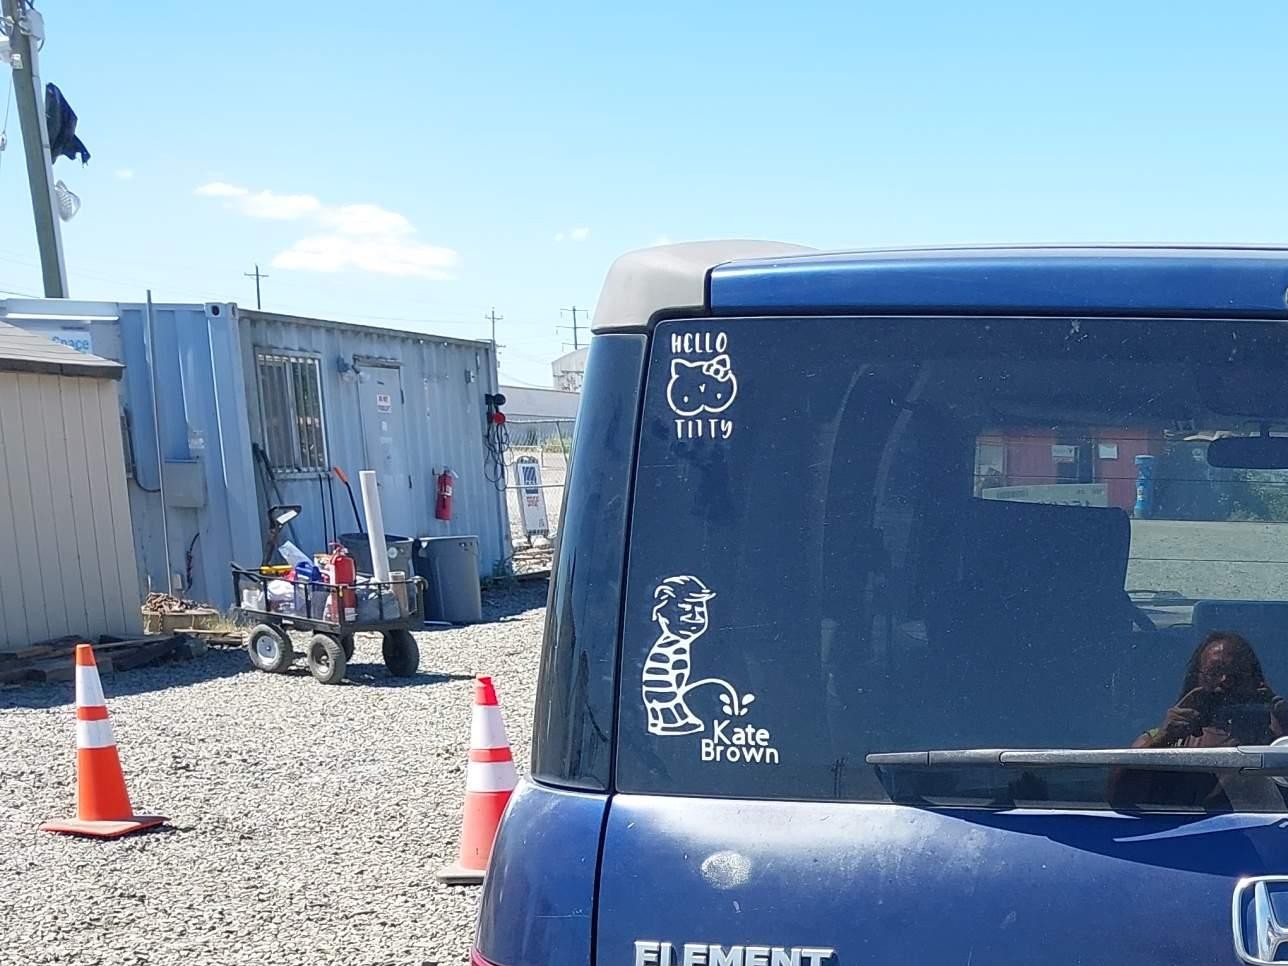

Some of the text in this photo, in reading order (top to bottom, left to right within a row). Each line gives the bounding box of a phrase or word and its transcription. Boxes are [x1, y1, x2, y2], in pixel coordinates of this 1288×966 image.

[671, 332, 728, 354] HELLO
[712, 719, 770, 746] Kate
[701, 740, 779, 764] Brown
